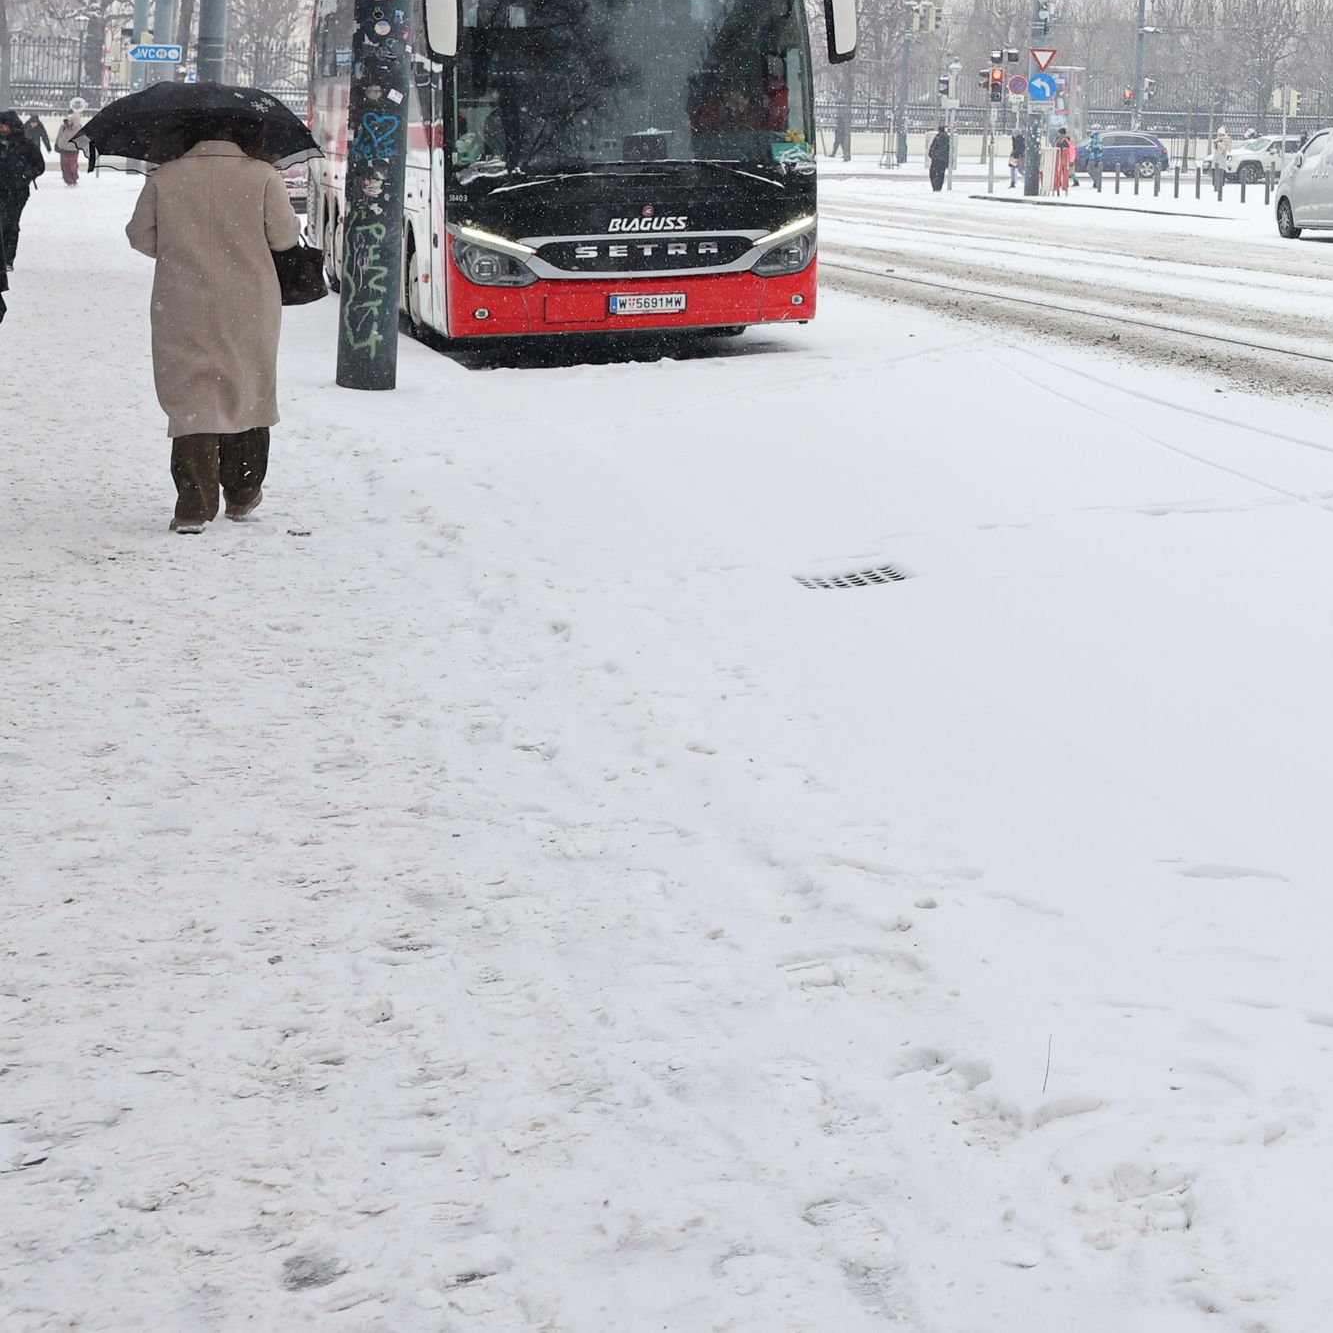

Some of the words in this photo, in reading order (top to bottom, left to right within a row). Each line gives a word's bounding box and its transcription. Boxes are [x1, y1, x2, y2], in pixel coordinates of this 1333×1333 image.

[137, 49, 155, 58] WC
[608, 216, 688, 232] BLAGUSS
[575, 241, 718, 259] SETRA
